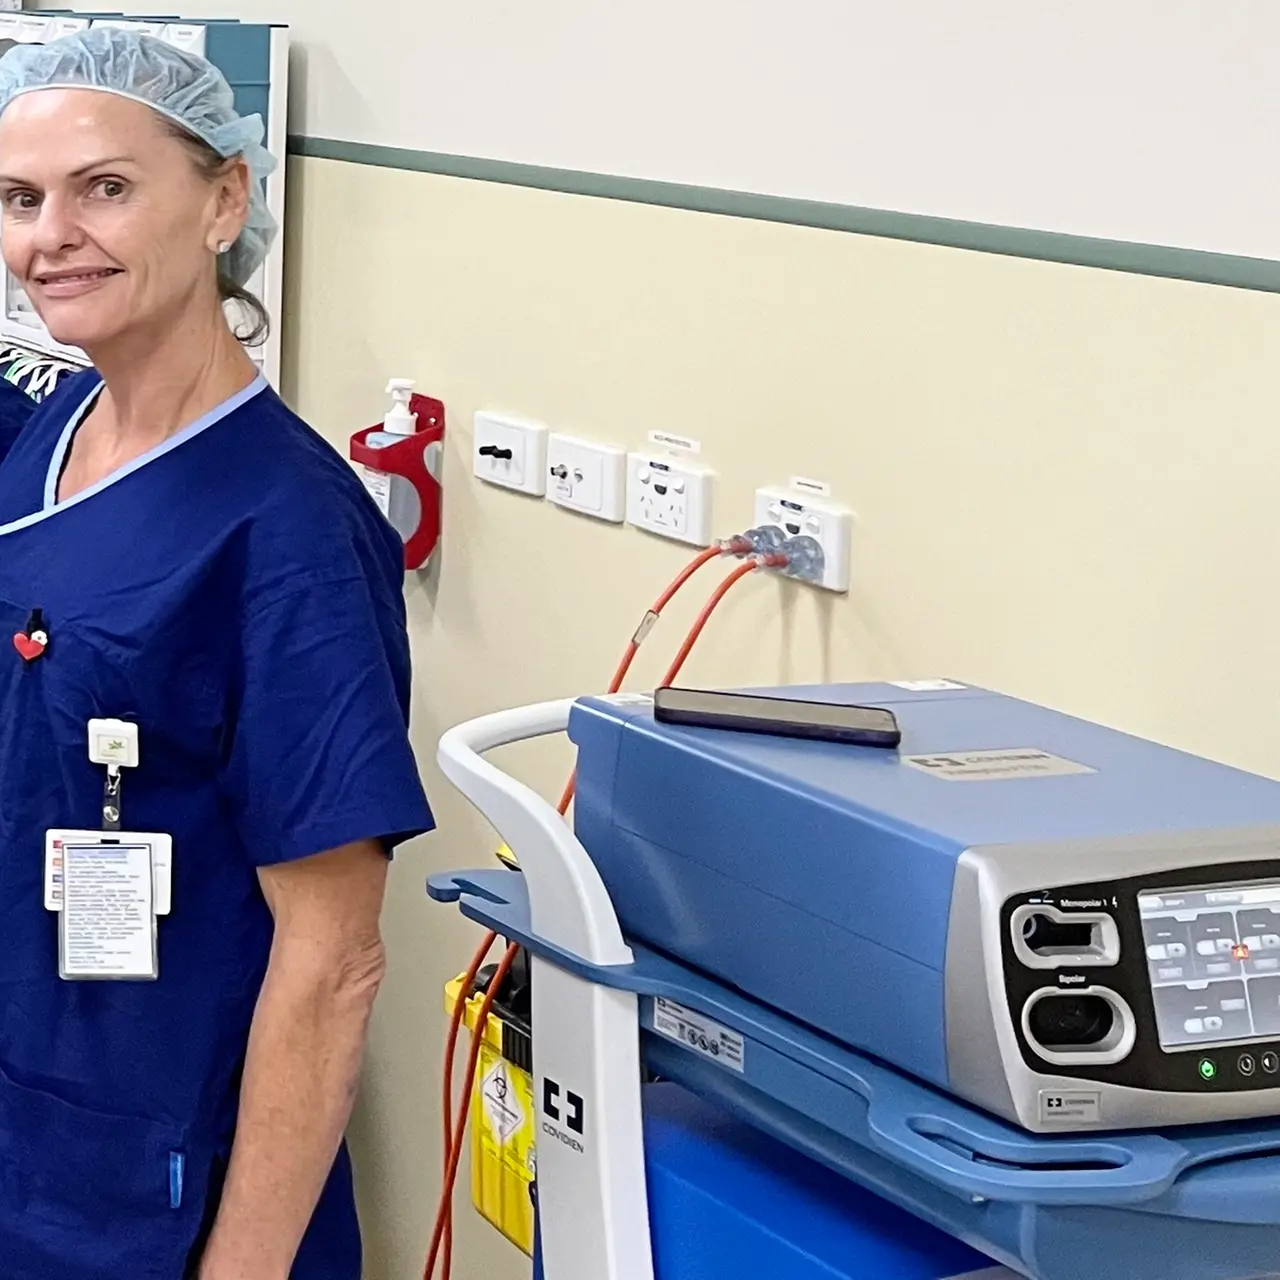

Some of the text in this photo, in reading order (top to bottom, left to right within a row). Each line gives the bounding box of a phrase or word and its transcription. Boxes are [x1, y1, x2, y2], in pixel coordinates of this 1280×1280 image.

[1060, 899, 1102, 908] Monopolar
[1059, 974, 1086, 984] Bipolar
[543, 1121, 584, 1153] COVIDIEN
